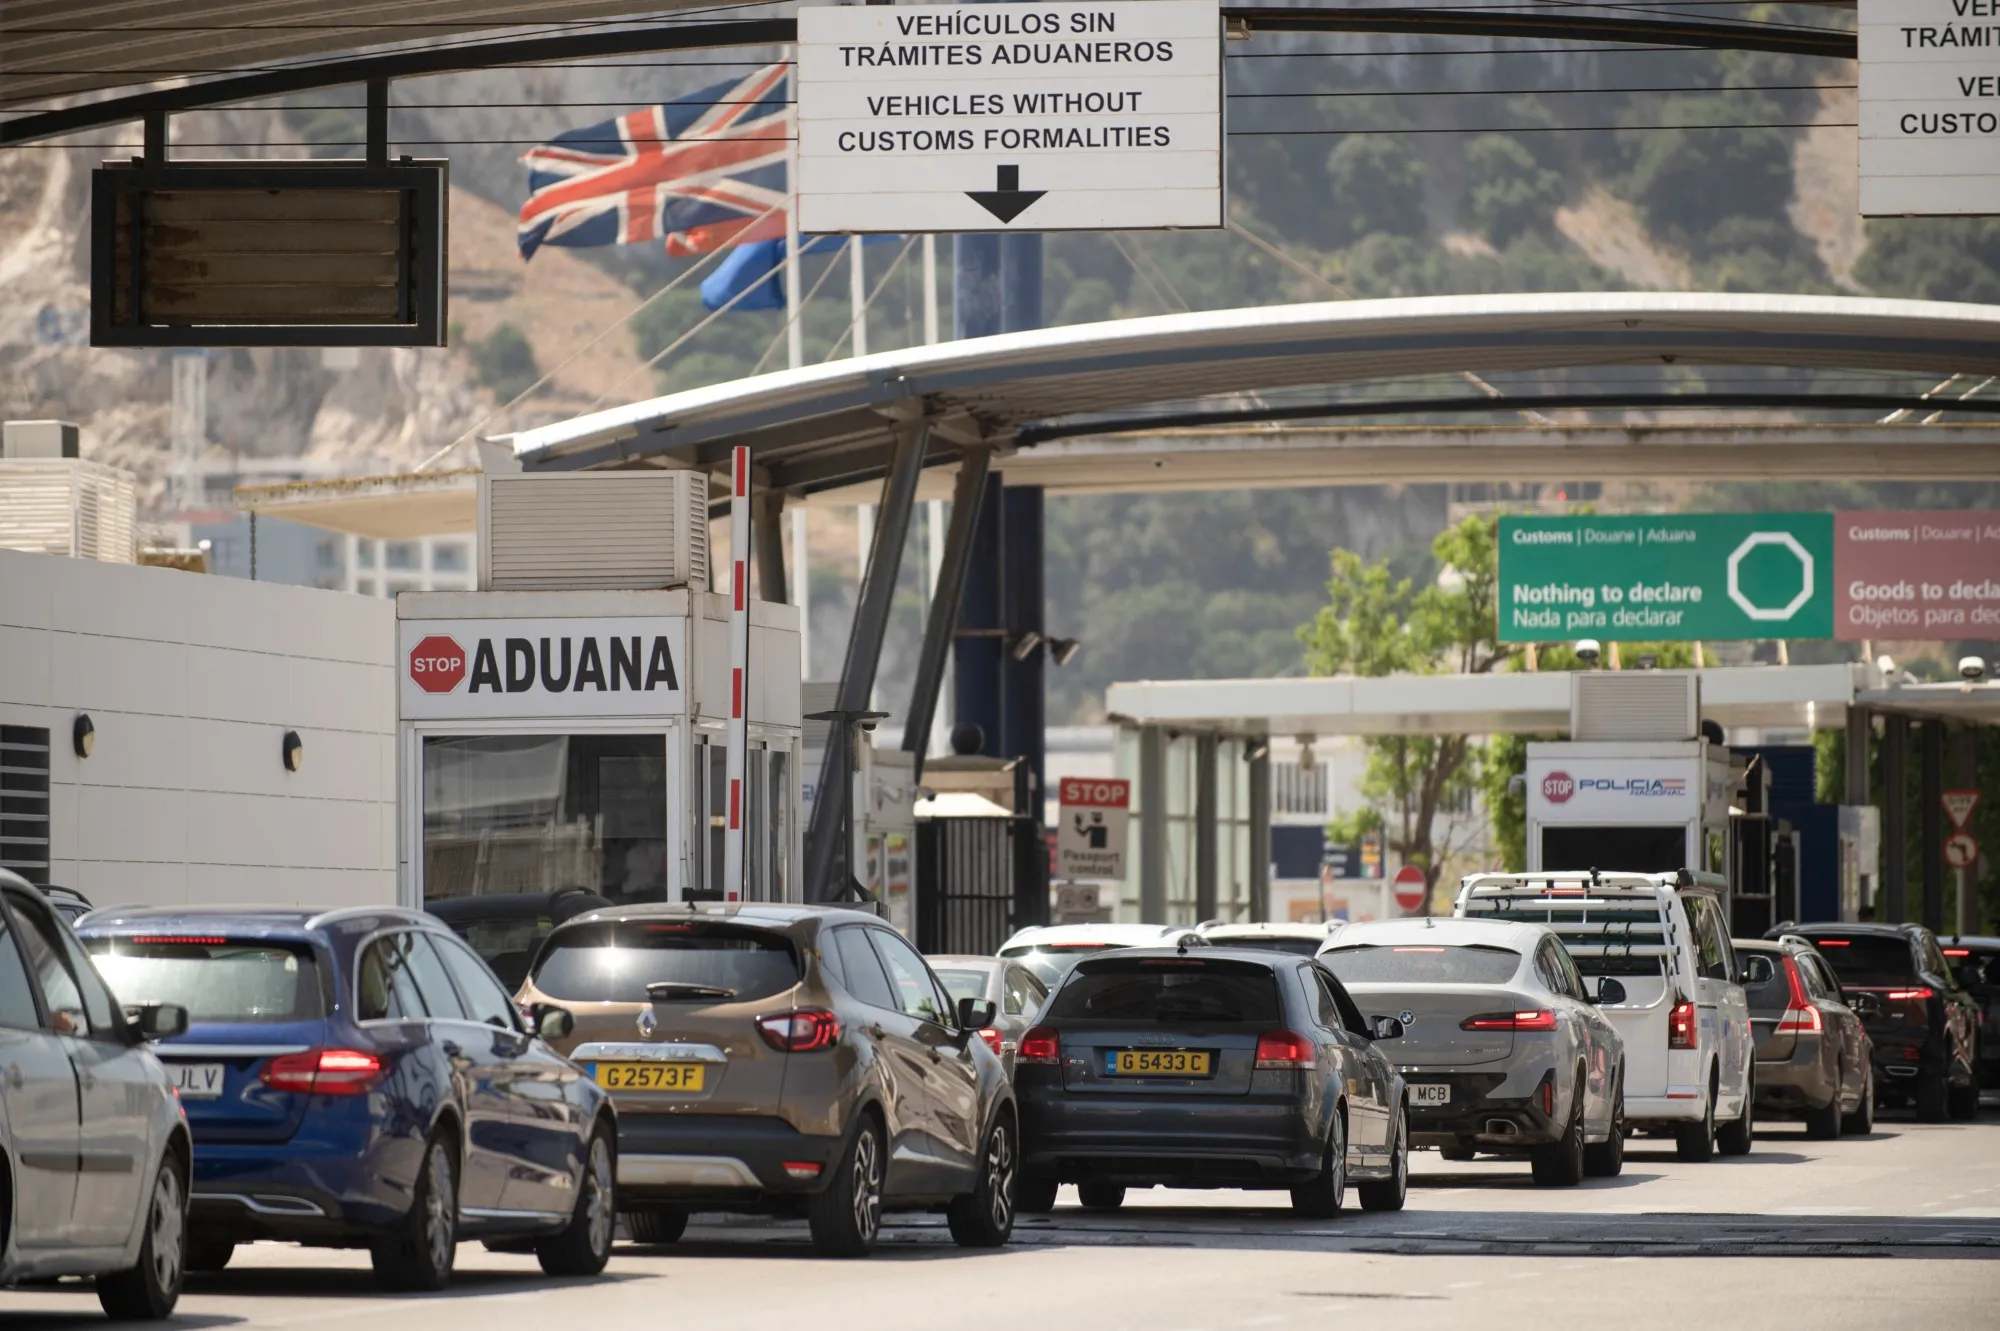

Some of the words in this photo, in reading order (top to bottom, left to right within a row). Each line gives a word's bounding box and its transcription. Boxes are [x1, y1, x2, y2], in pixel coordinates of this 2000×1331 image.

[897, 10, 1060, 36] VEHÍCULOS
[1070, 12, 1116, 33] SIN
[839, 41, 982, 67] TRÁMITES
[991, 41, 1174, 65] ADUANEROS
[1957, 76, 2000, 97] VE
[867, 94, 1004, 116] VEHICLES
[1013, 91, 1142, 114] WITHOUT
[1900, 113, 2000, 134] CUSTO
[838, 129, 974, 152] CUSTOMS
[984, 126, 1171, 149] FORMALITIES
[1512, 529, 1573, 544] Customs
[1585, 528, 1636, 543] Douane
[1647, 528, 1696, 542] Aduana
[1849, 526, 1910, 541] Customs
[1921, 525, 1972, 539] Douane
[1513, 583, 1595, 607] Nothing
[1602, 585, 1623, 603] to
[1629, 582, 1702, 602] declare
[1849, 580, 1915, 601] Goods
[1921, 582, 1943, 600] to
[1513, 608, 1560, 628] Nada
[1567, 611, 1606, 631] para
[1612, 606, 1684, 626] declarar
[1849, 604, 1919, 629] Objetos
[1925, 608, 1965, 628] para
[414, 657, 461, 673] STOP
[468, 636, 679, 694] ADUANA
[1066, 783, 1125, 802] STOP
[1544, 780, 1573, 796] STOP
[1579, 779, 1664, 790] POLICIA
[1418, 1086, 1446, 1101] MCB
